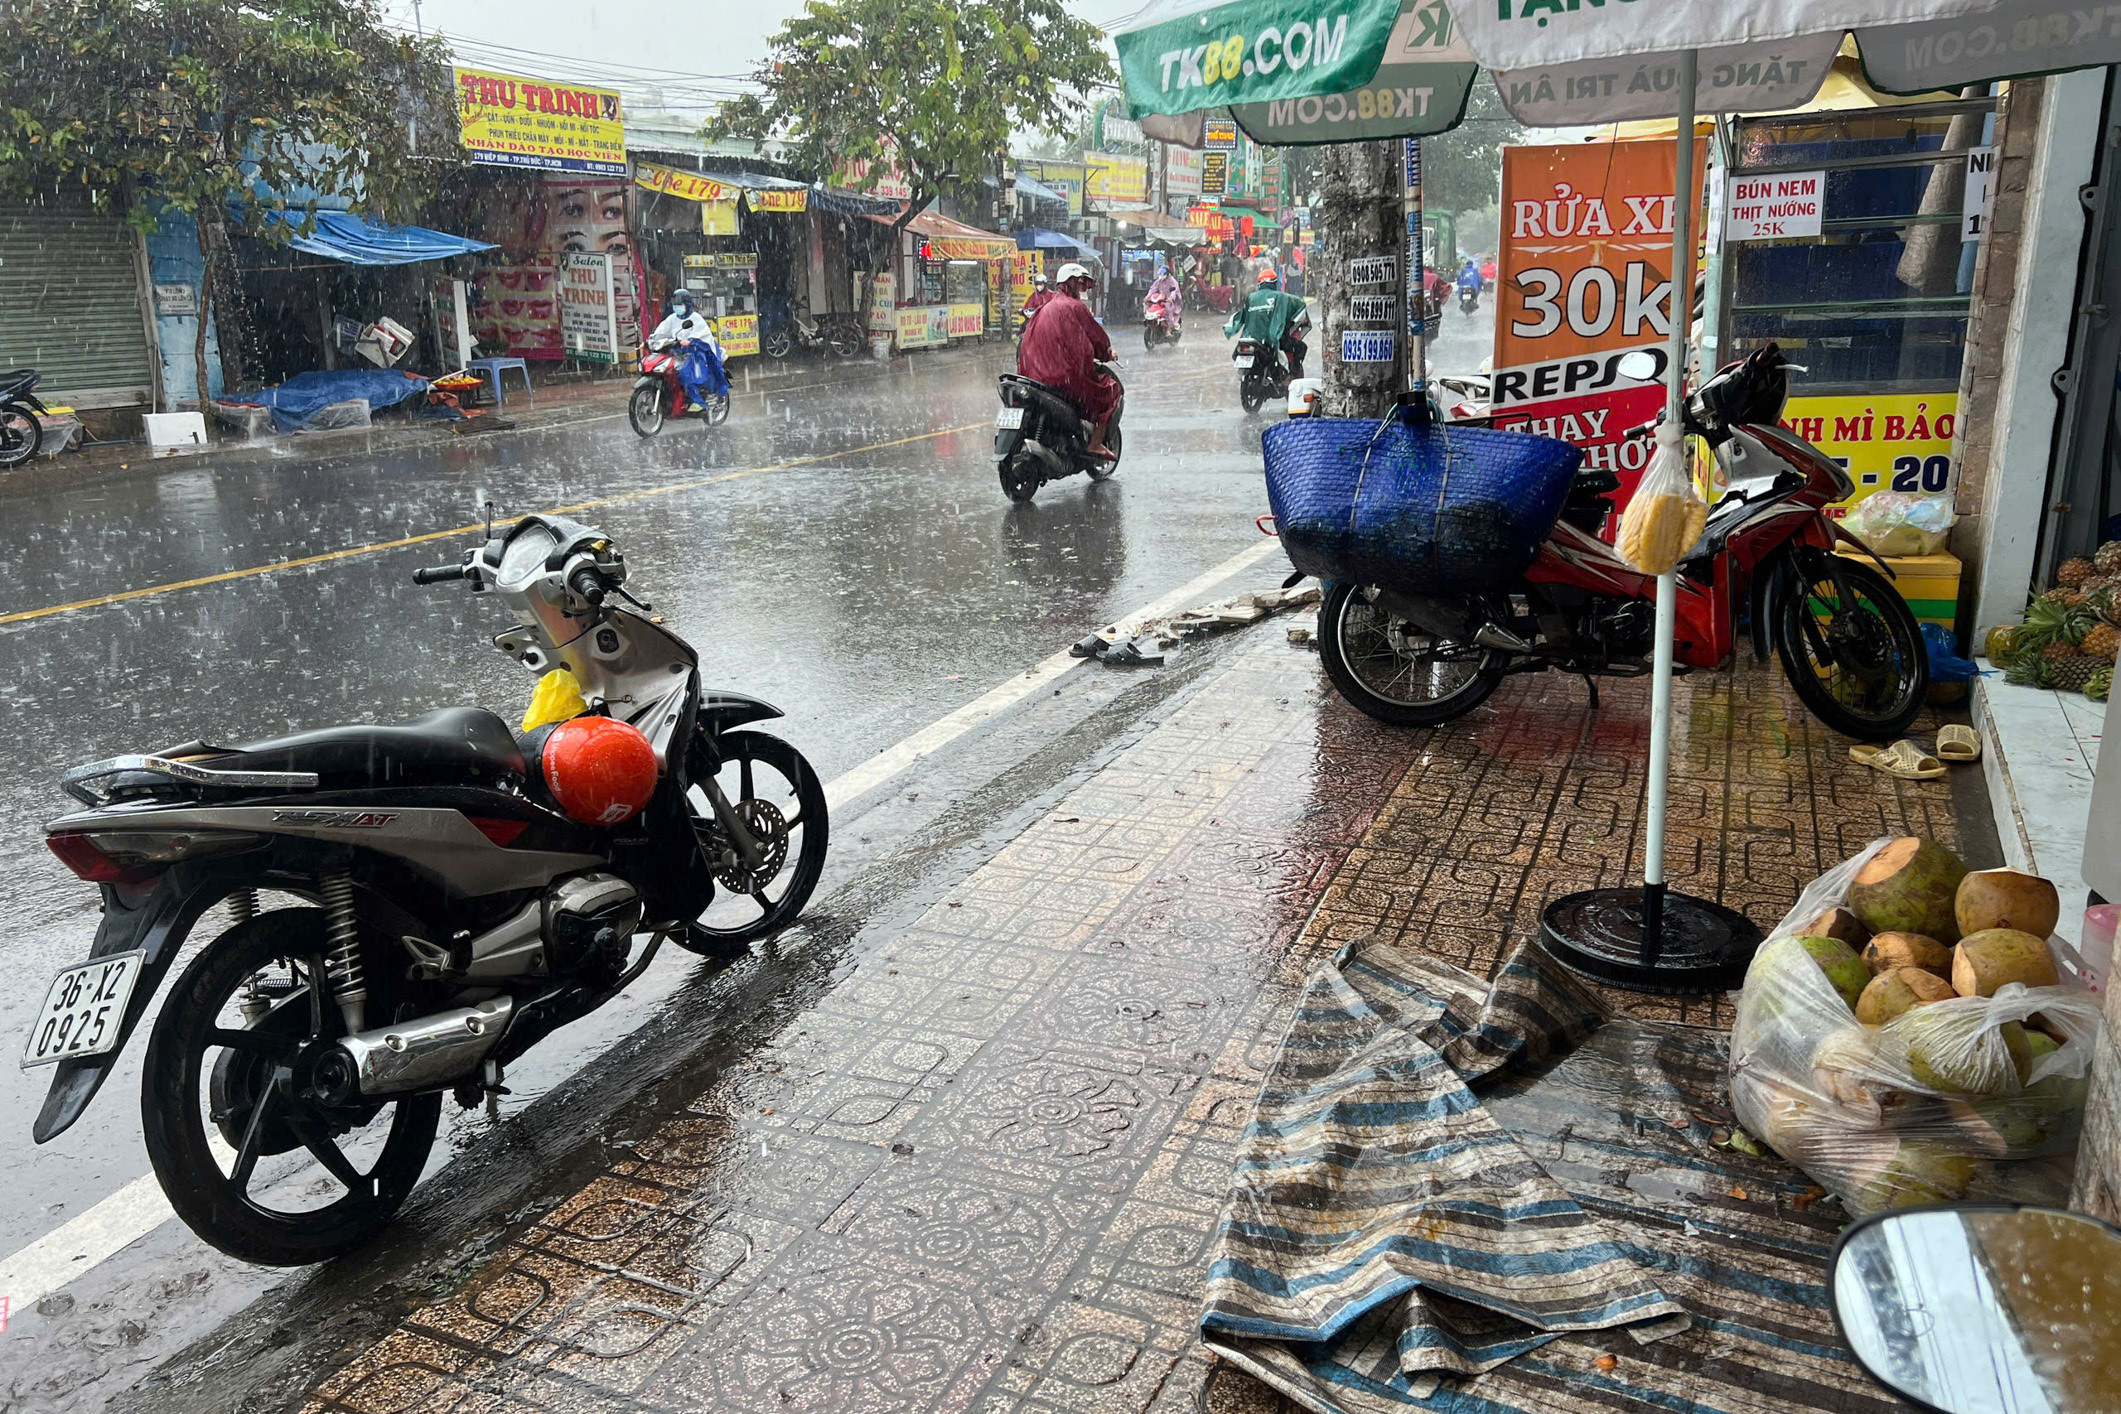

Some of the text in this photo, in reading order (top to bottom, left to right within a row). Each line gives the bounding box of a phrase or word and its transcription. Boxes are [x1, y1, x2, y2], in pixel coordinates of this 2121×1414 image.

[1159, 14, 1348, 93] TK88.COM
[461, 74, 600, 119] THU TRINH
[466, 137, 622, 161] NHẬN ĐÀO TẠO HỌC VIÊN
[687, 179, 721, 199] 179
[785, 190, 805, 207] 179
[1736, 177, 1816, 200] BÚN NEM
[1511, 182, 1615, 239] RỬA
[1732, 200, 1816, 222] THỊT NƯỚNG
[1752, 221, 1785, 237] 25K
[570, 267, 597, 284] THU
[563, 287, 606, 305] TRINH
[1511, 261, 1674, 339] 30k
[1505, 407, 1610, 443] THAY
[1833, 408, 1875, 442] MÌ
[1883, 402, 1956, 441] BẢO
[1891, 455, 1950, 493] 20
[54, 960, 129, 1012] 36-X2
[36, 1005, 111, 1057] 0925
